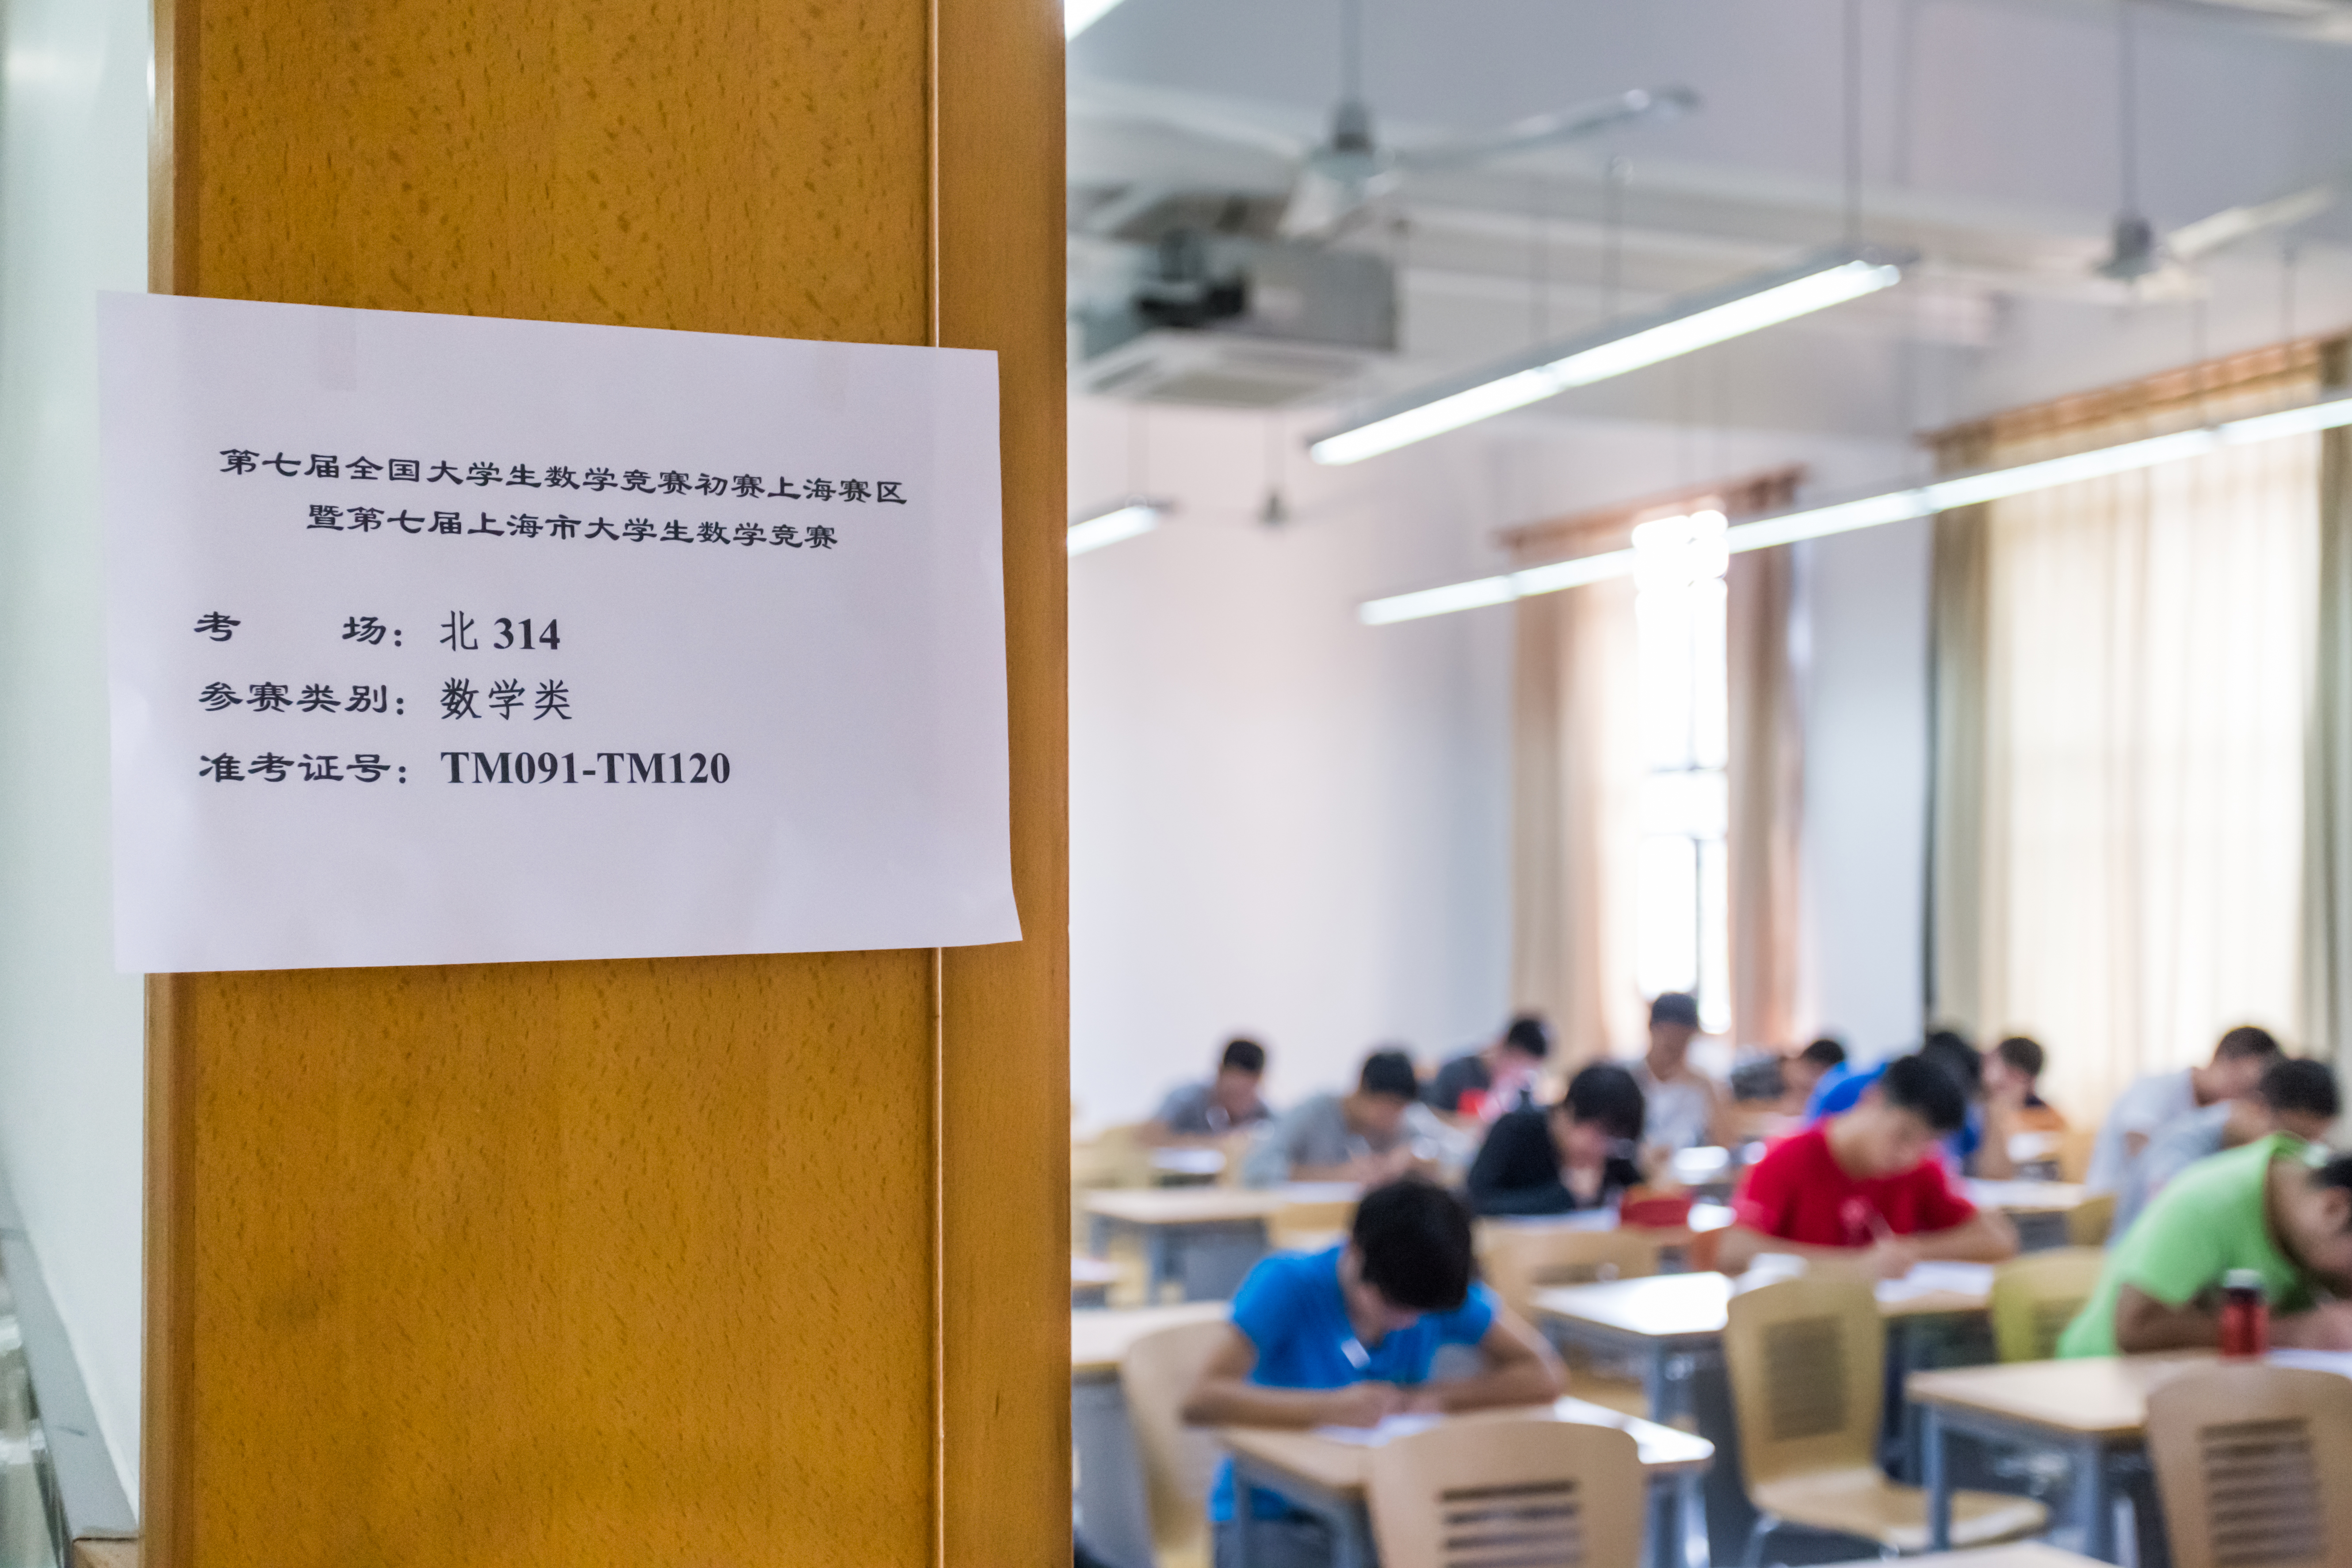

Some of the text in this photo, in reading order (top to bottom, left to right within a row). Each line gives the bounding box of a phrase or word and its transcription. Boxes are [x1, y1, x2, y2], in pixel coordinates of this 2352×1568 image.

[219, 448, 908, 505] 第七届全国大学生数学竞赛初赛上海赛区
[306, 504, 838, 550] 暨第七届上海市大学生数学竞赛
[493, 617, 561, 650] 314
[440, 752, 730, 784] TM091-TM120
